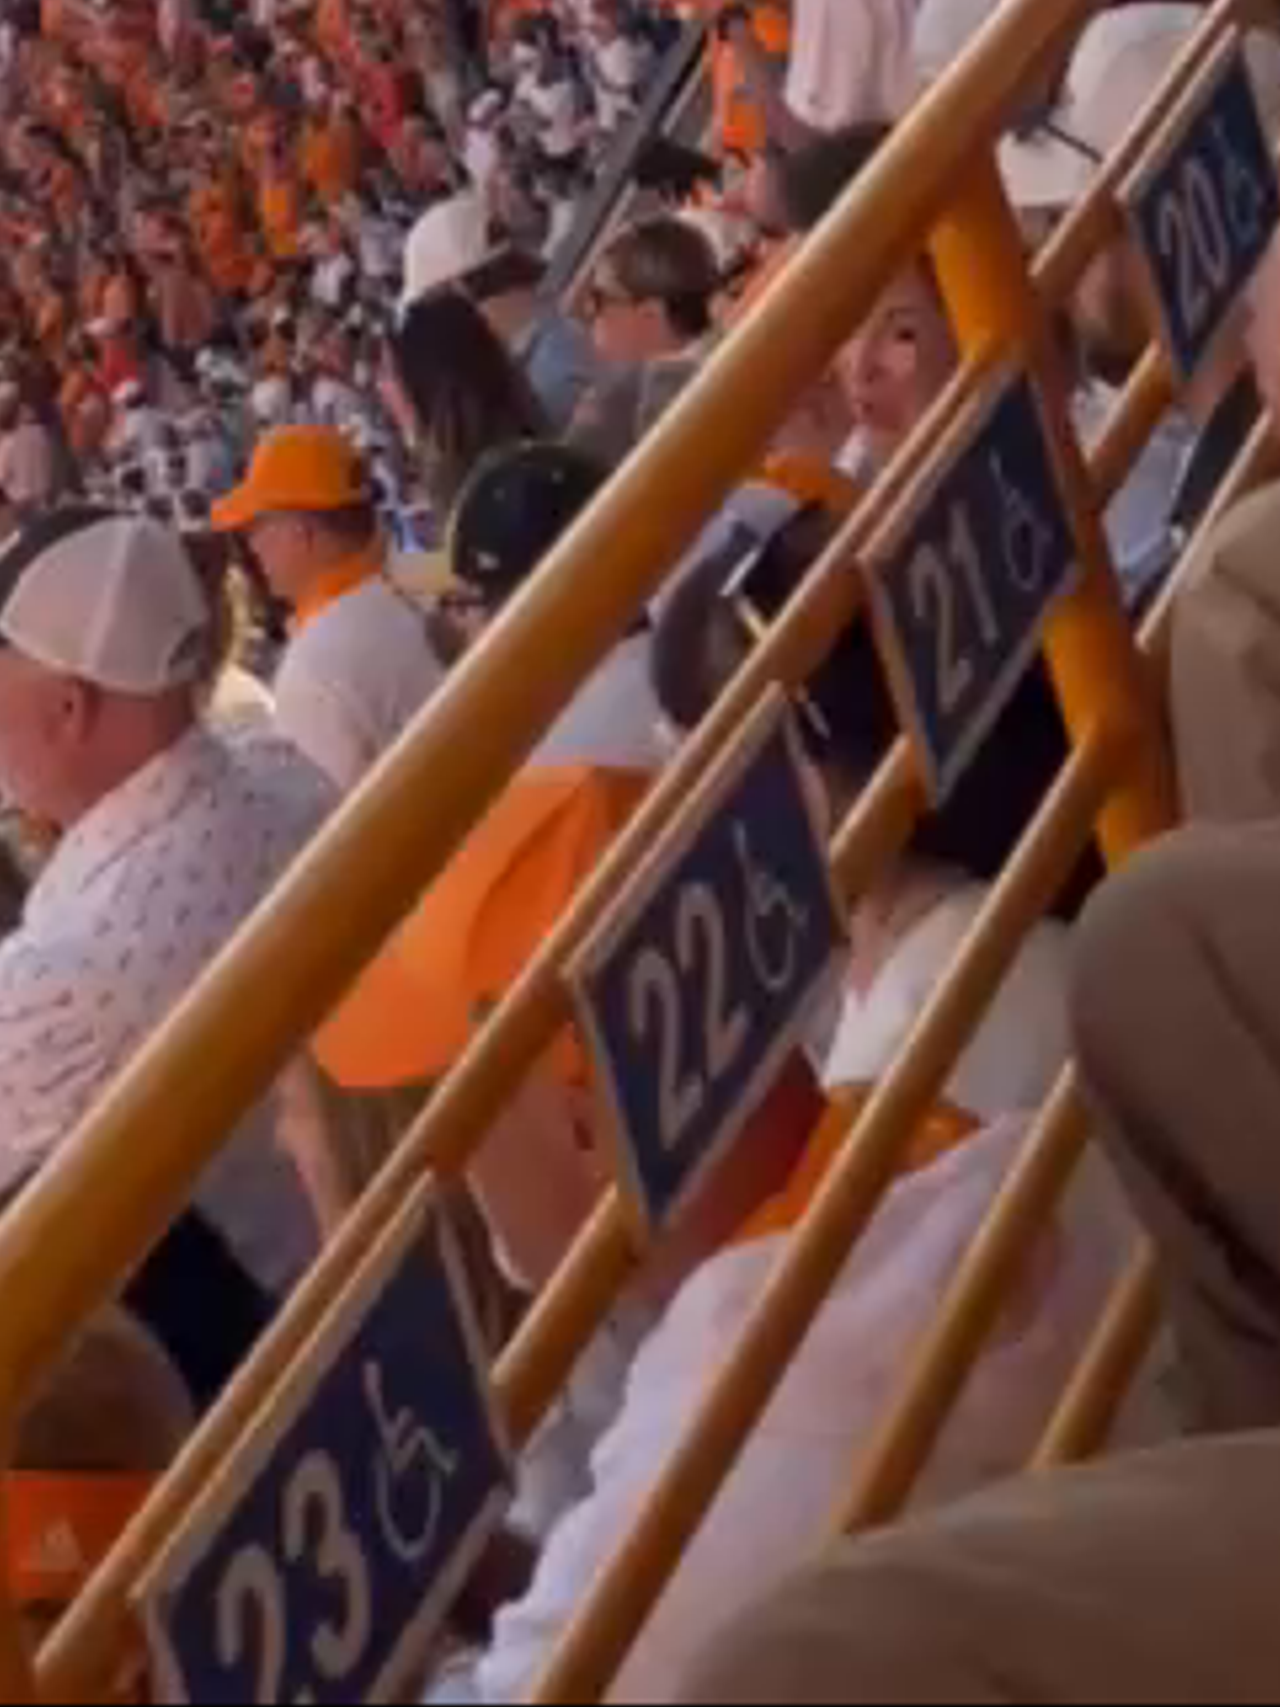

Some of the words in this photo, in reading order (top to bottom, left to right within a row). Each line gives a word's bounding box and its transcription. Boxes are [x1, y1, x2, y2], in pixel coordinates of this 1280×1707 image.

[1158, 159, 1228, 336] 20
[908, 498, 1001, 716] 21
[629, 883, 749, 1152] 22
[217, 1448, 372, 1705] 23
